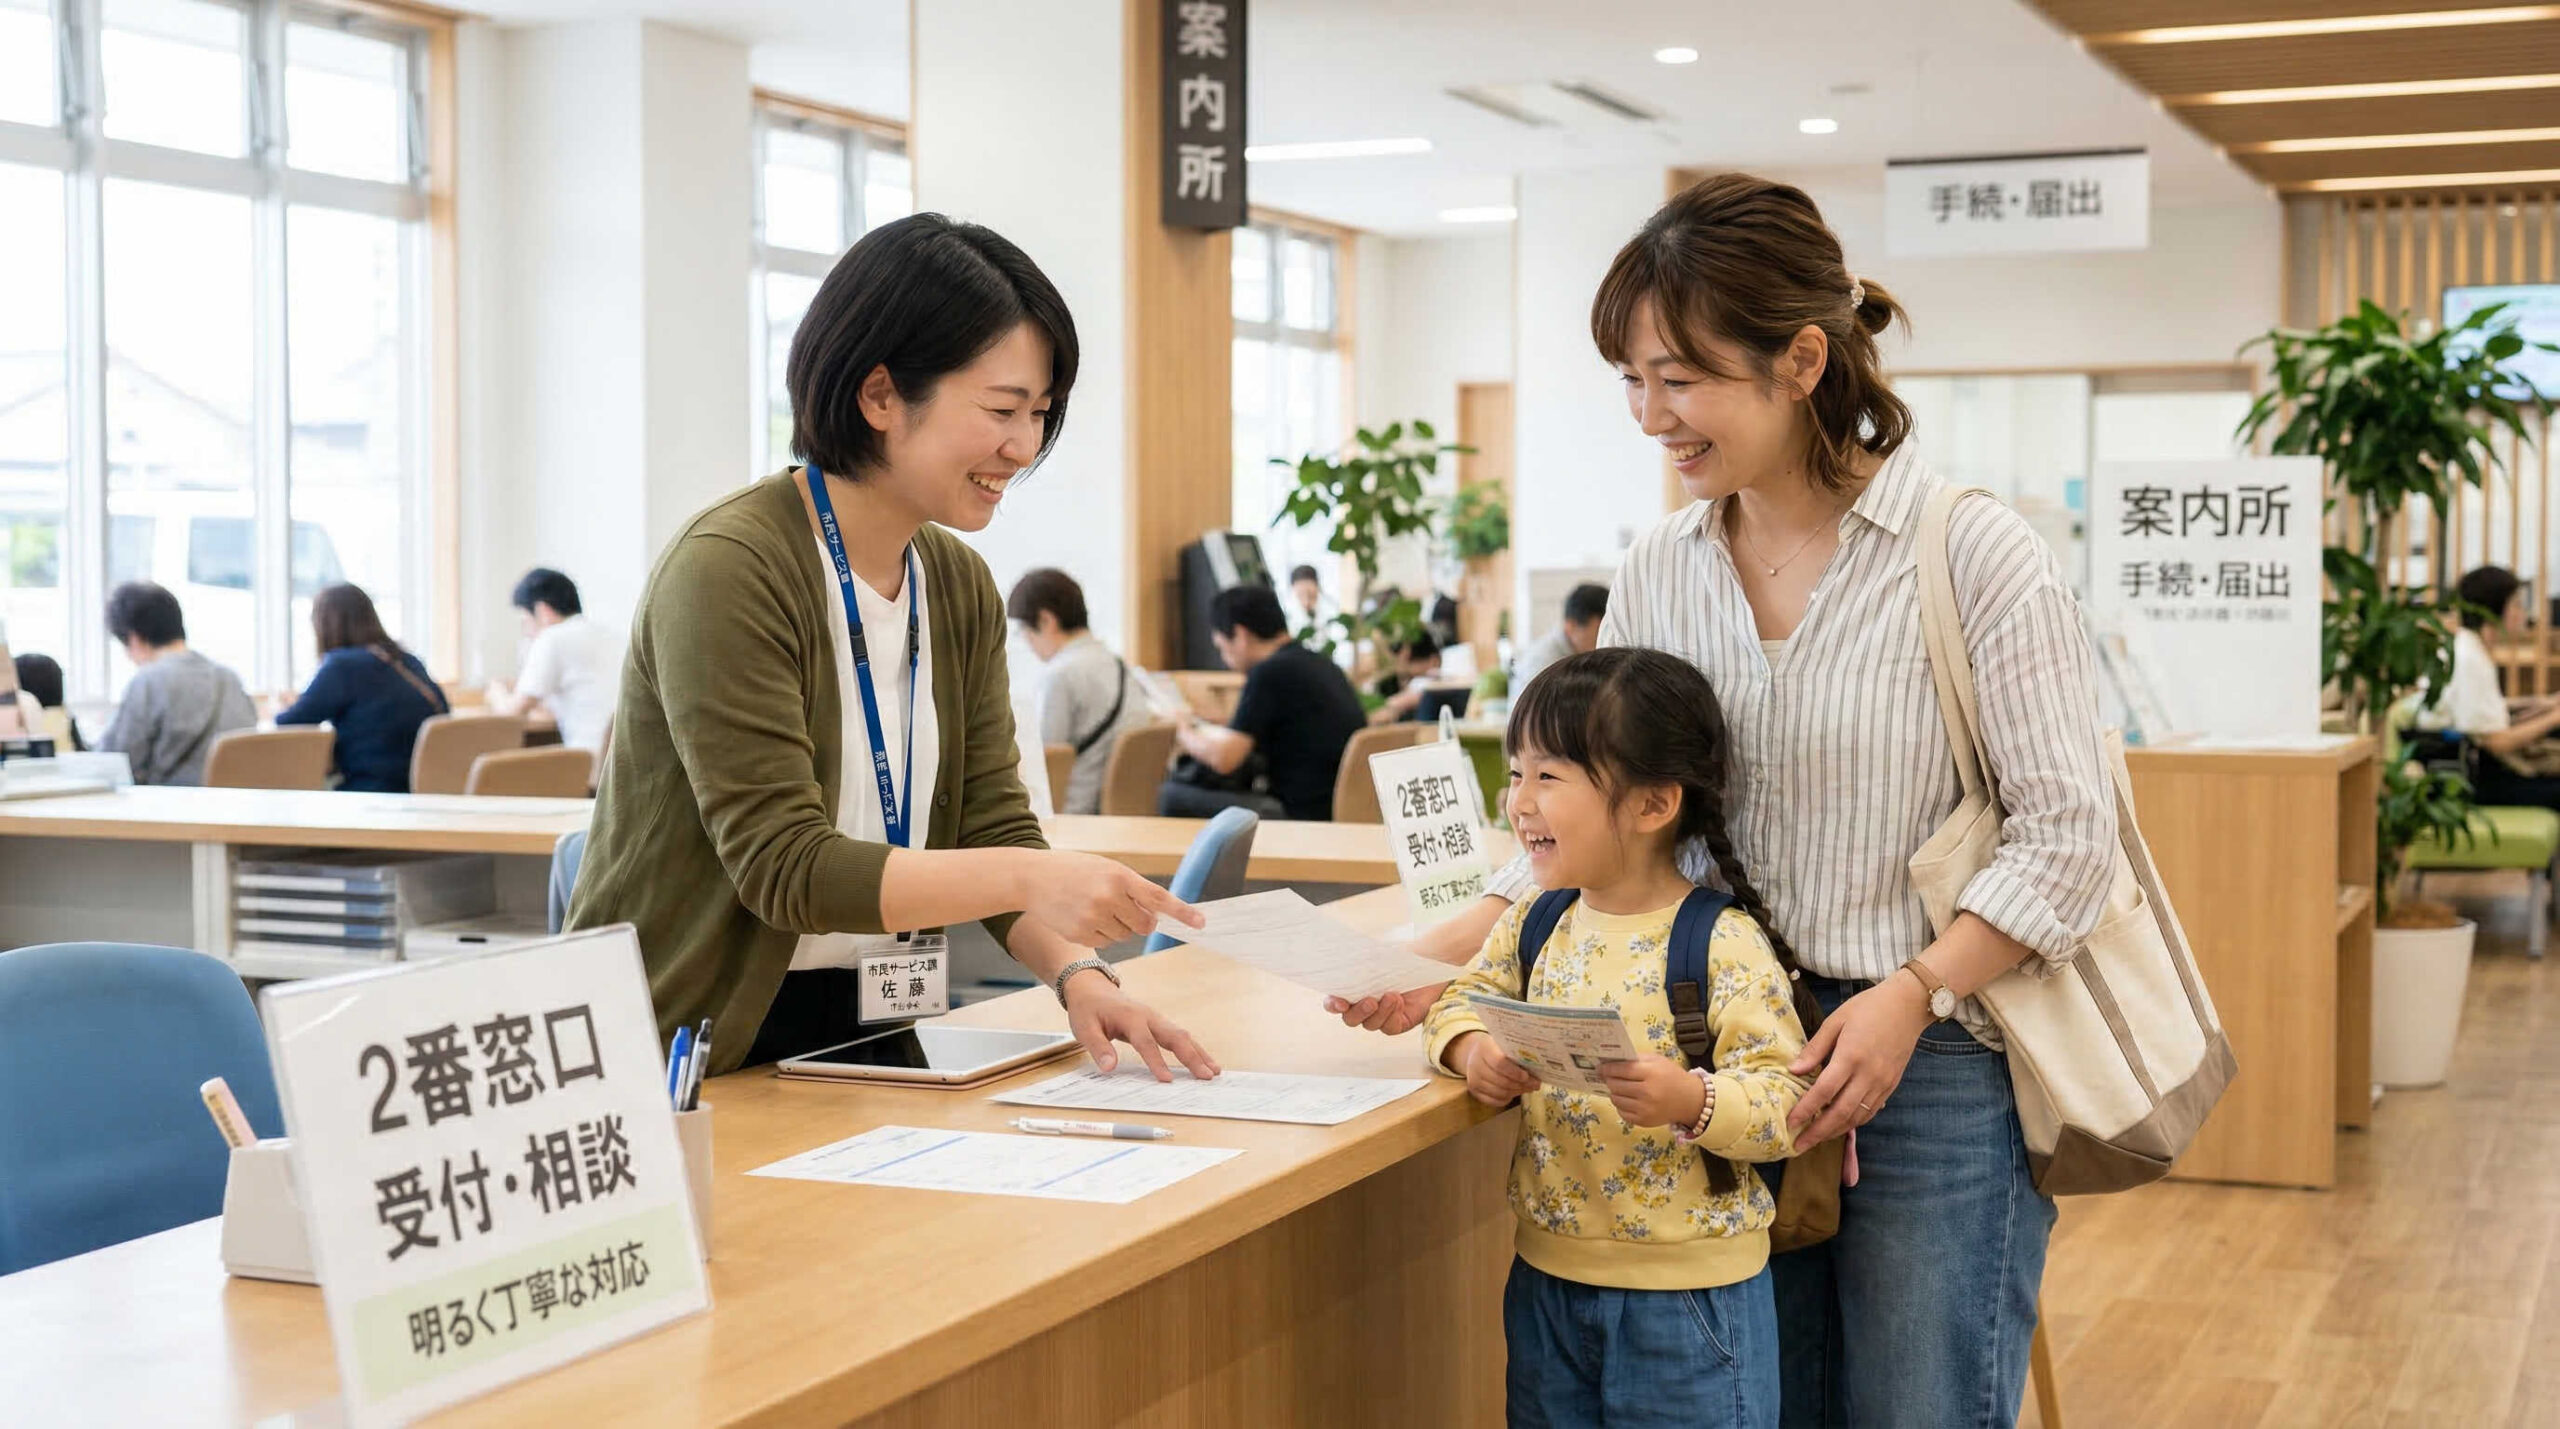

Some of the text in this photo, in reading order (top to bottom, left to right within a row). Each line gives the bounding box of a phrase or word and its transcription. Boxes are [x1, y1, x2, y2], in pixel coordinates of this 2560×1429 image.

[1177, 1, 1228, 202] 案内所
[1930, 179, 2102, 222] 手続・届出
[2121, 483, 2291, 538] 案内所
[821, 511, 849, 584] 市民サービス
[2121, 560, 2290, 599] 手続・届出
[1397, 775, 1459, 819] 2番窓口
[881, 976, 926, 999] 佐藤
[360, 1004, 606, 1133] 2番窓口
[376, 1113, 636, 1260] 受付・相談
[410, 1241, 650, 1357] 明るく丁寧な対応
